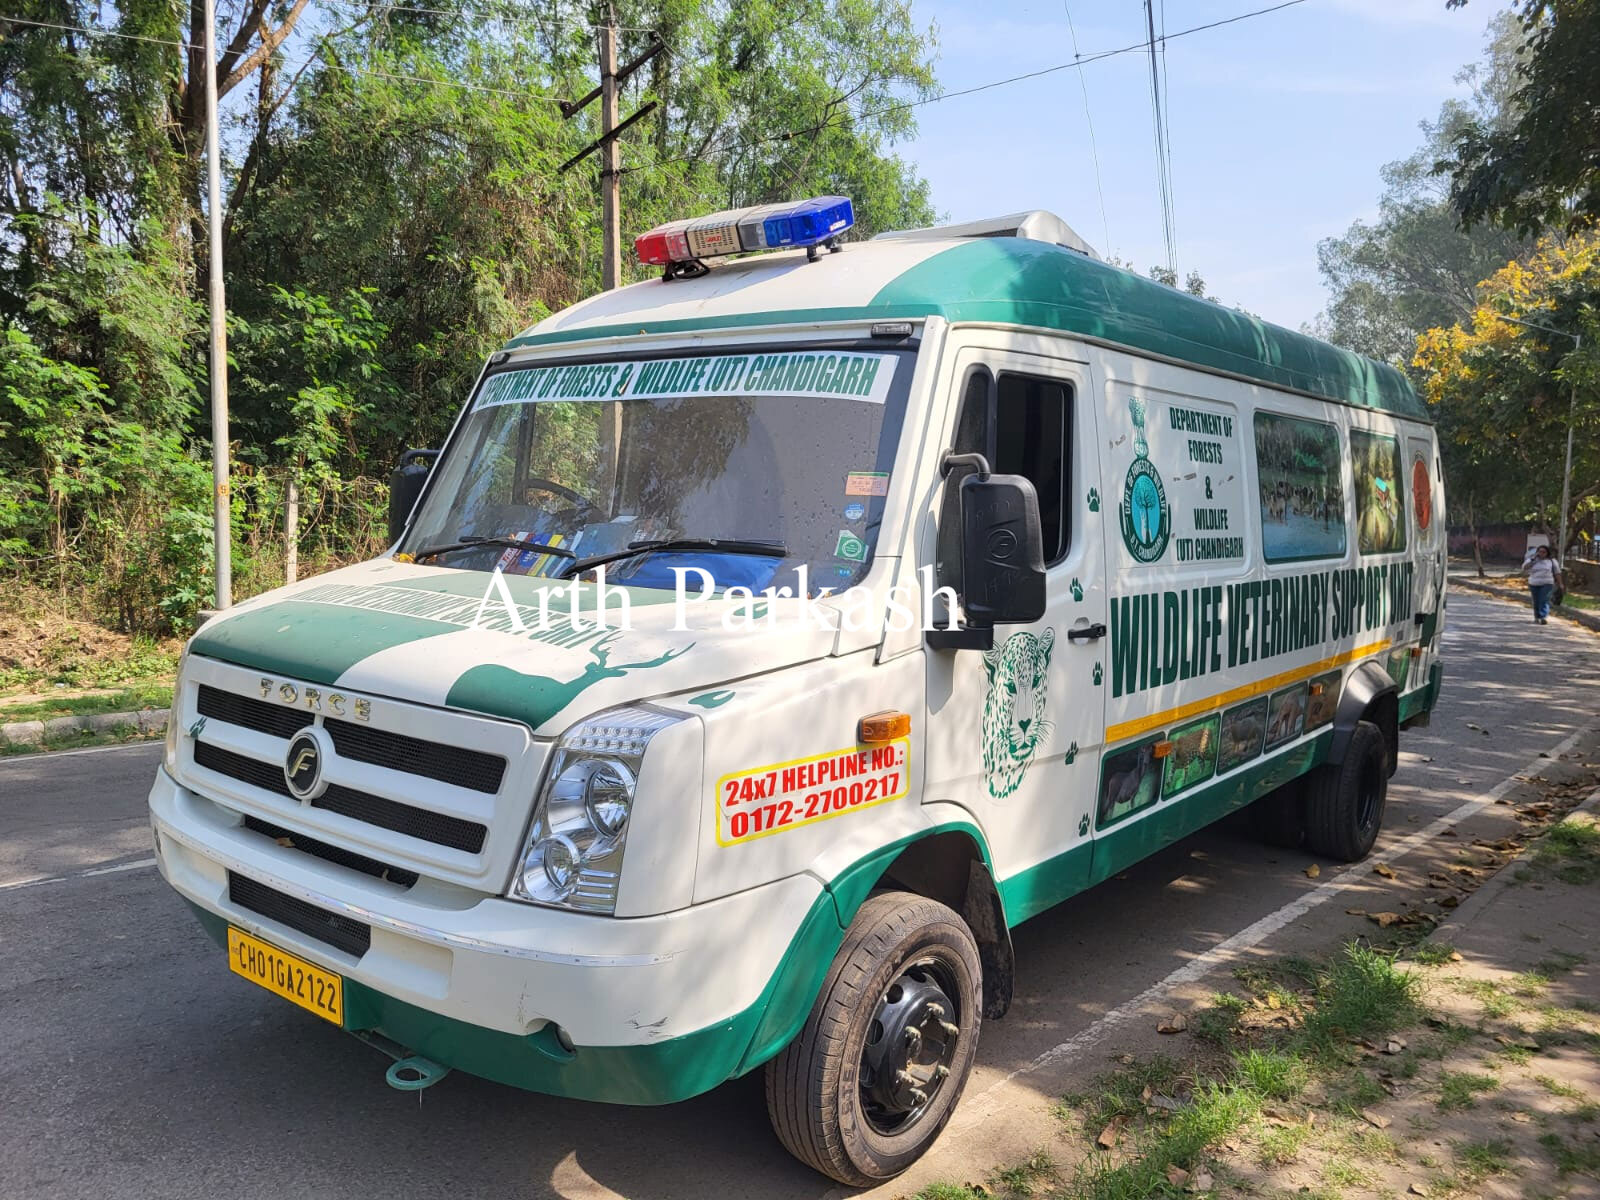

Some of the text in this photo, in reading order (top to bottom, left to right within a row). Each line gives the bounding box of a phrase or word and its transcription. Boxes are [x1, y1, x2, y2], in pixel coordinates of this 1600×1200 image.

[537, 366, 561, 399] OF
[556, 364, 619, 398] FORESTS
[611, 363, 634, 398] &
[632, 358, 712, 395] WILDLIFE
[704, 356, 749, 392] (UT)
[744, 354, 881, 397] CHANDIGARH
[1169, 407, 1232, 438] DEPARTMENT OF
[1187, 439, 1223, 465] FORESTS
[1205, 475, 1213, 499] &
[1194, 508, 1229, 531] WILDLIFE
[1176, 537, 1244, 561] (UT) CHANDIGARH
[1110, 561, 1414, 699] WILDLIFE VETERINARY SUPPORT UNIT
[260, 678, 371, 721] FORCE
[725, 745, 904, 807] 24x7 HELPLINE NO.:
[730, 772, 900, 838] 0172-2700217
[239, 941, 337, 1014] CH01GA2122
